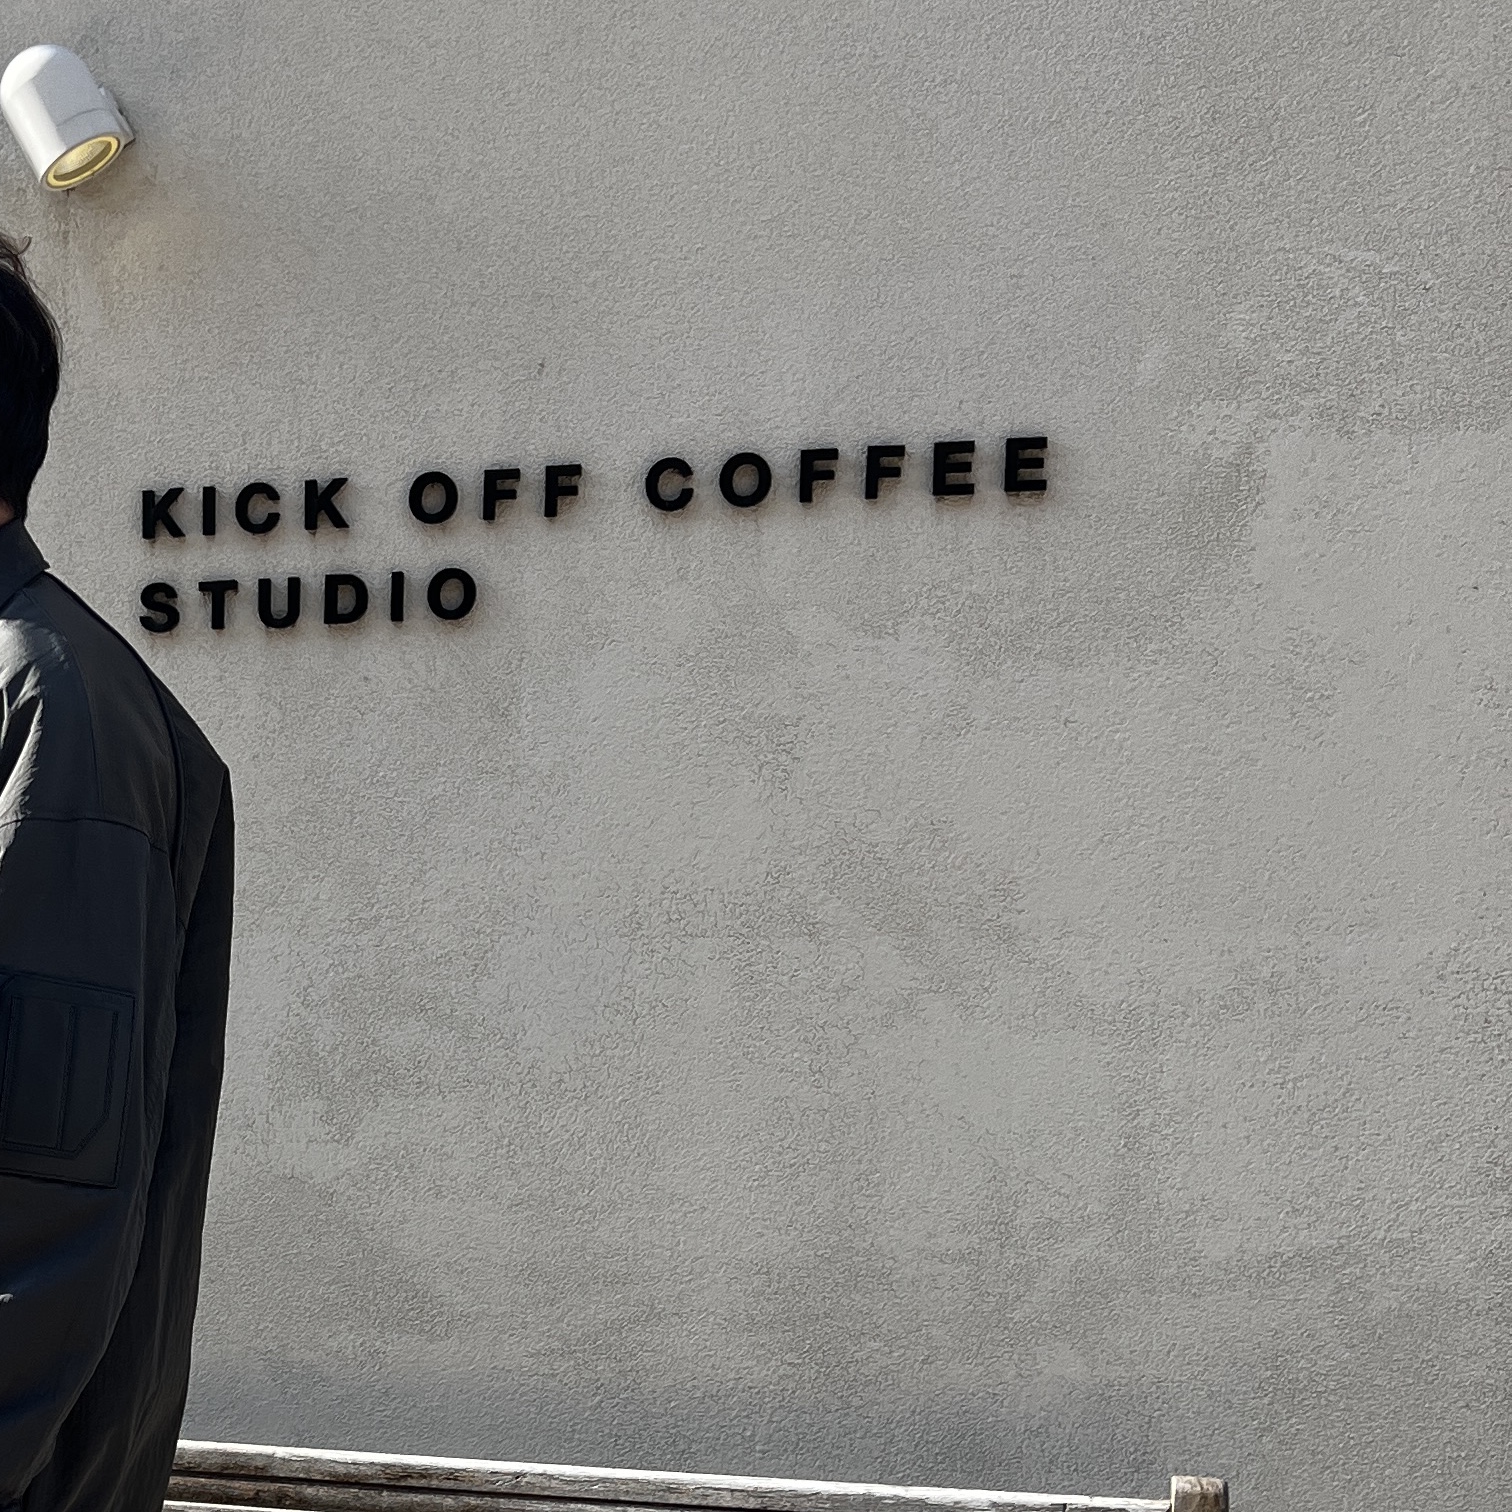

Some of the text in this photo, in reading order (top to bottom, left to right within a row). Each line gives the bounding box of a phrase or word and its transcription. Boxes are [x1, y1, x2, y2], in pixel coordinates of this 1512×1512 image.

[140, 435, 1049, 541] KICK OFF COFFEE
[138, 566, 478, 635] STUDIO
